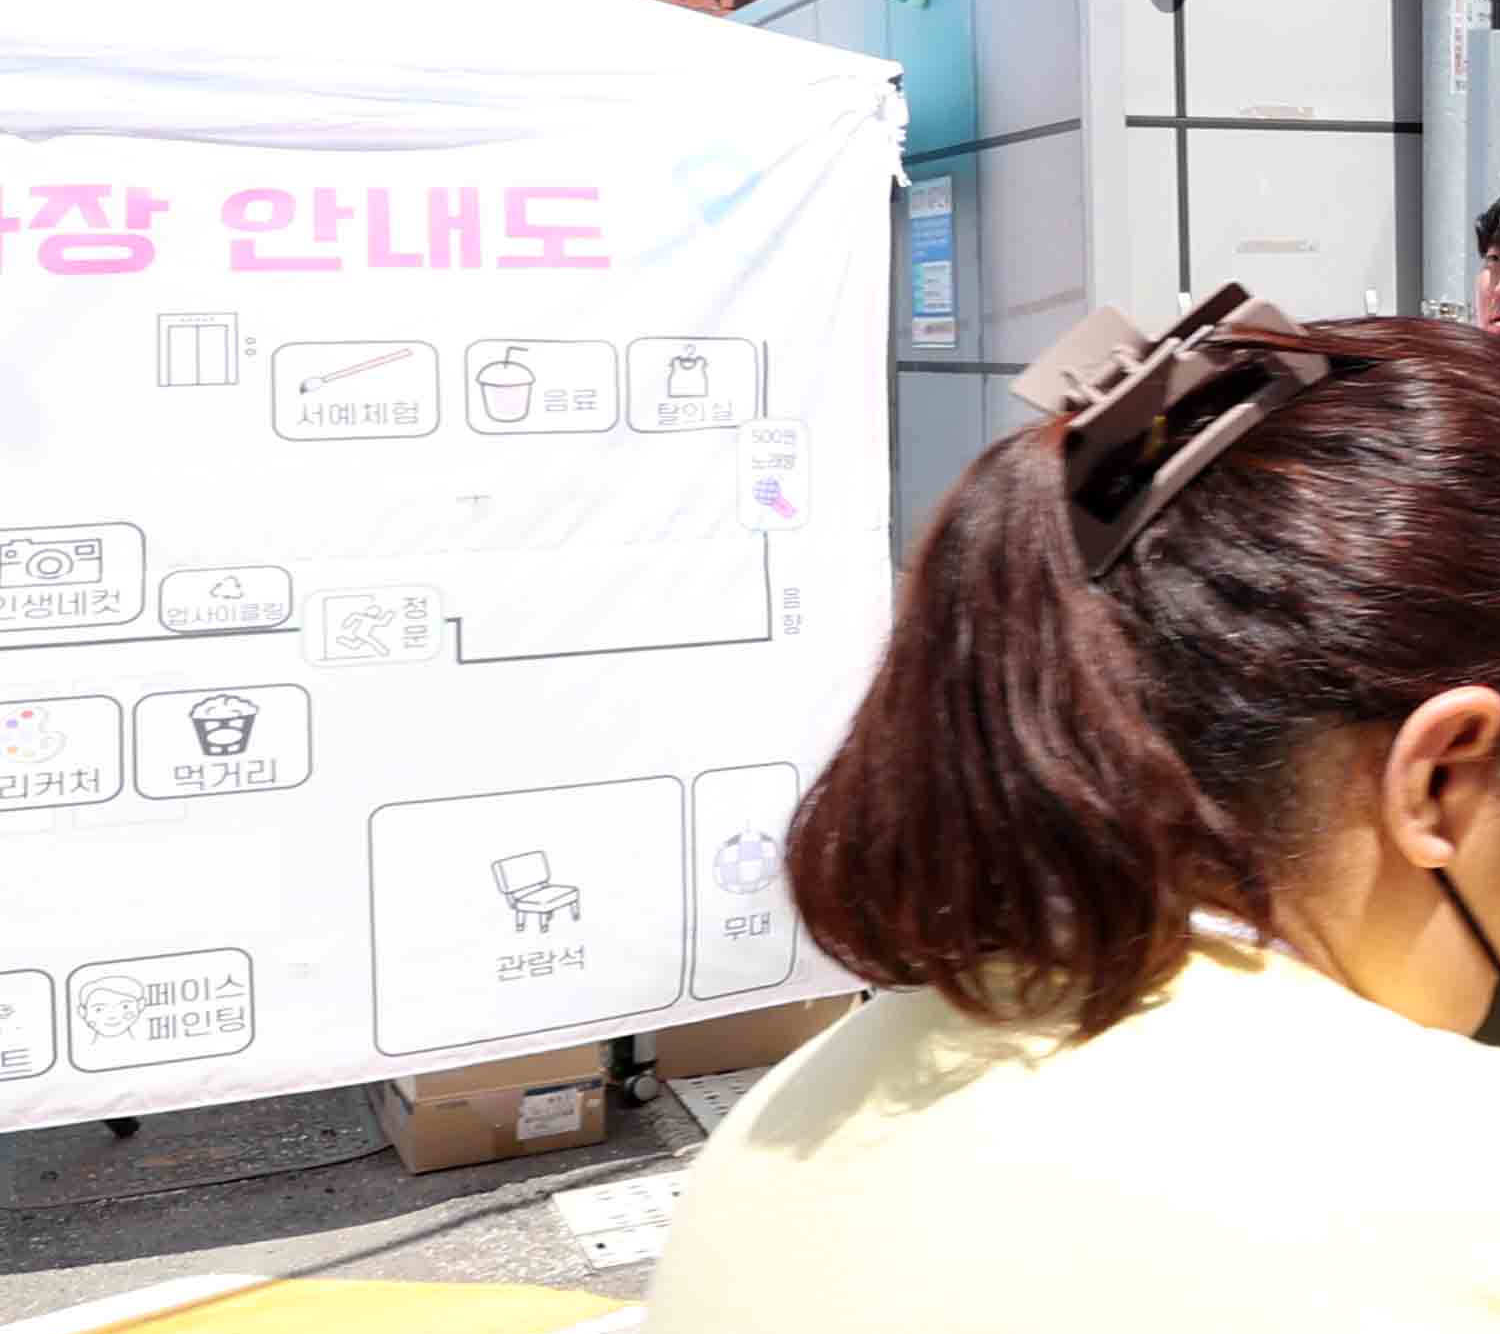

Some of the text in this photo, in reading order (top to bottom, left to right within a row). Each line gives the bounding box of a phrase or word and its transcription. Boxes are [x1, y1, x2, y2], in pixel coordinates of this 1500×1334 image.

[220, 186, 612, 272] 안내도
[296, 401, 420, 427] 서예체험
[543, 388, 599, 413] 음료
[657, 399, 734, 426] 탈의실
[166, 602, 285, 627] 업사이클링
[402, 596, 429, 650] 정문
[783, 587, 803, 635] 음향
[173, 758, 279, 789] 먹거리
[723, 912, 771, 940] 무대
[495, 945, 586, 983] 관람석
[145, 973, 248, 1007] 페이스
[147, 1006, 247, 1041] 페인팅
